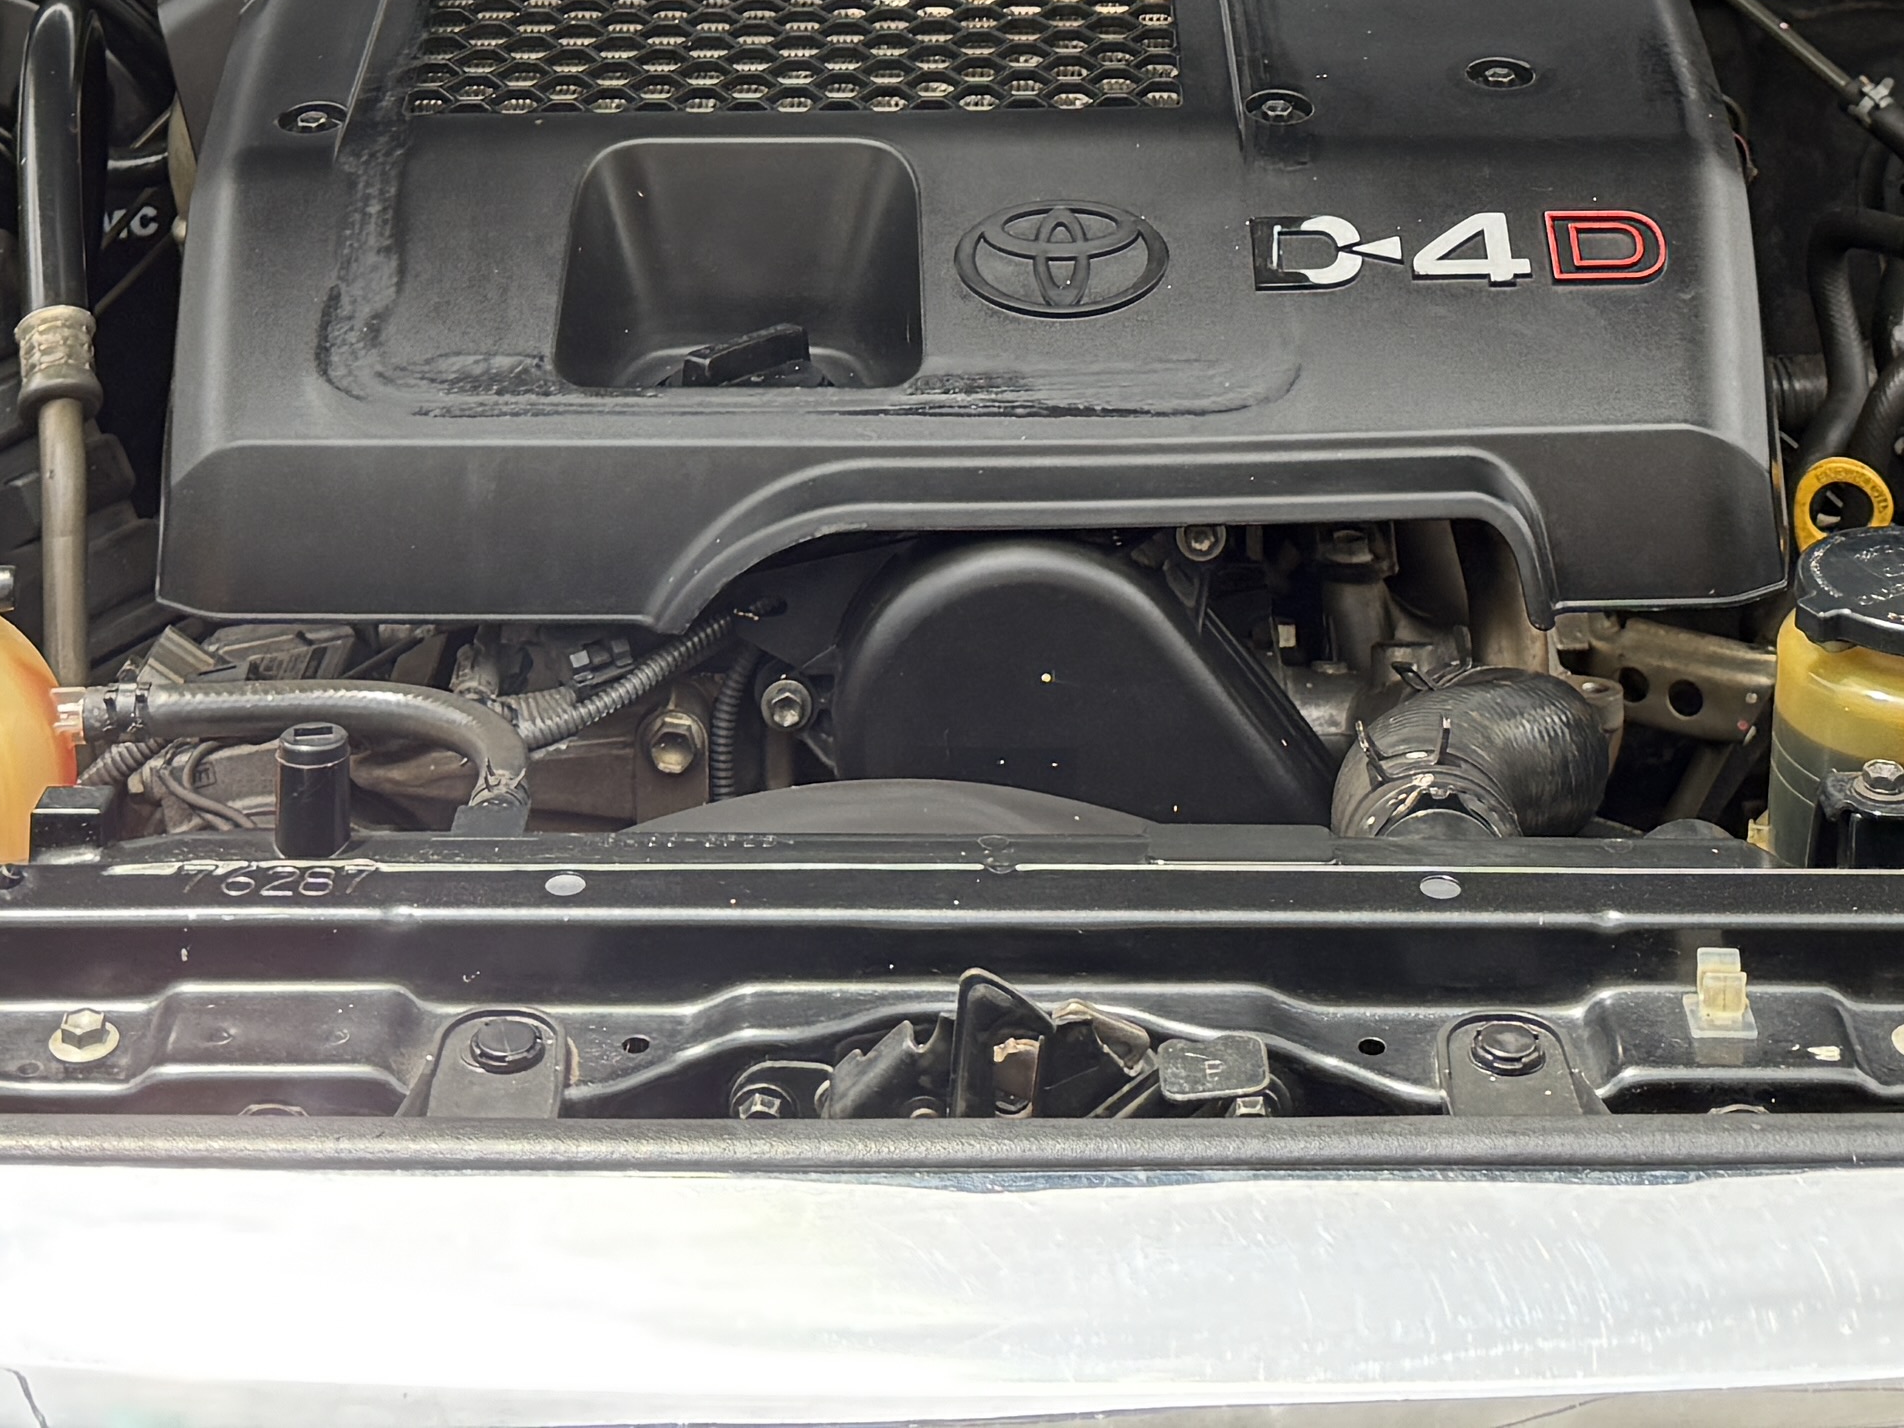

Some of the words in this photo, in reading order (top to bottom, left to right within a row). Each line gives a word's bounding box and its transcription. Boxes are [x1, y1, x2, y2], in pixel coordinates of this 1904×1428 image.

[103, 206, 159, 238] VC
[1248, 208, 1668, 292] D-4D
[176, 860, 379, 896] 76287
